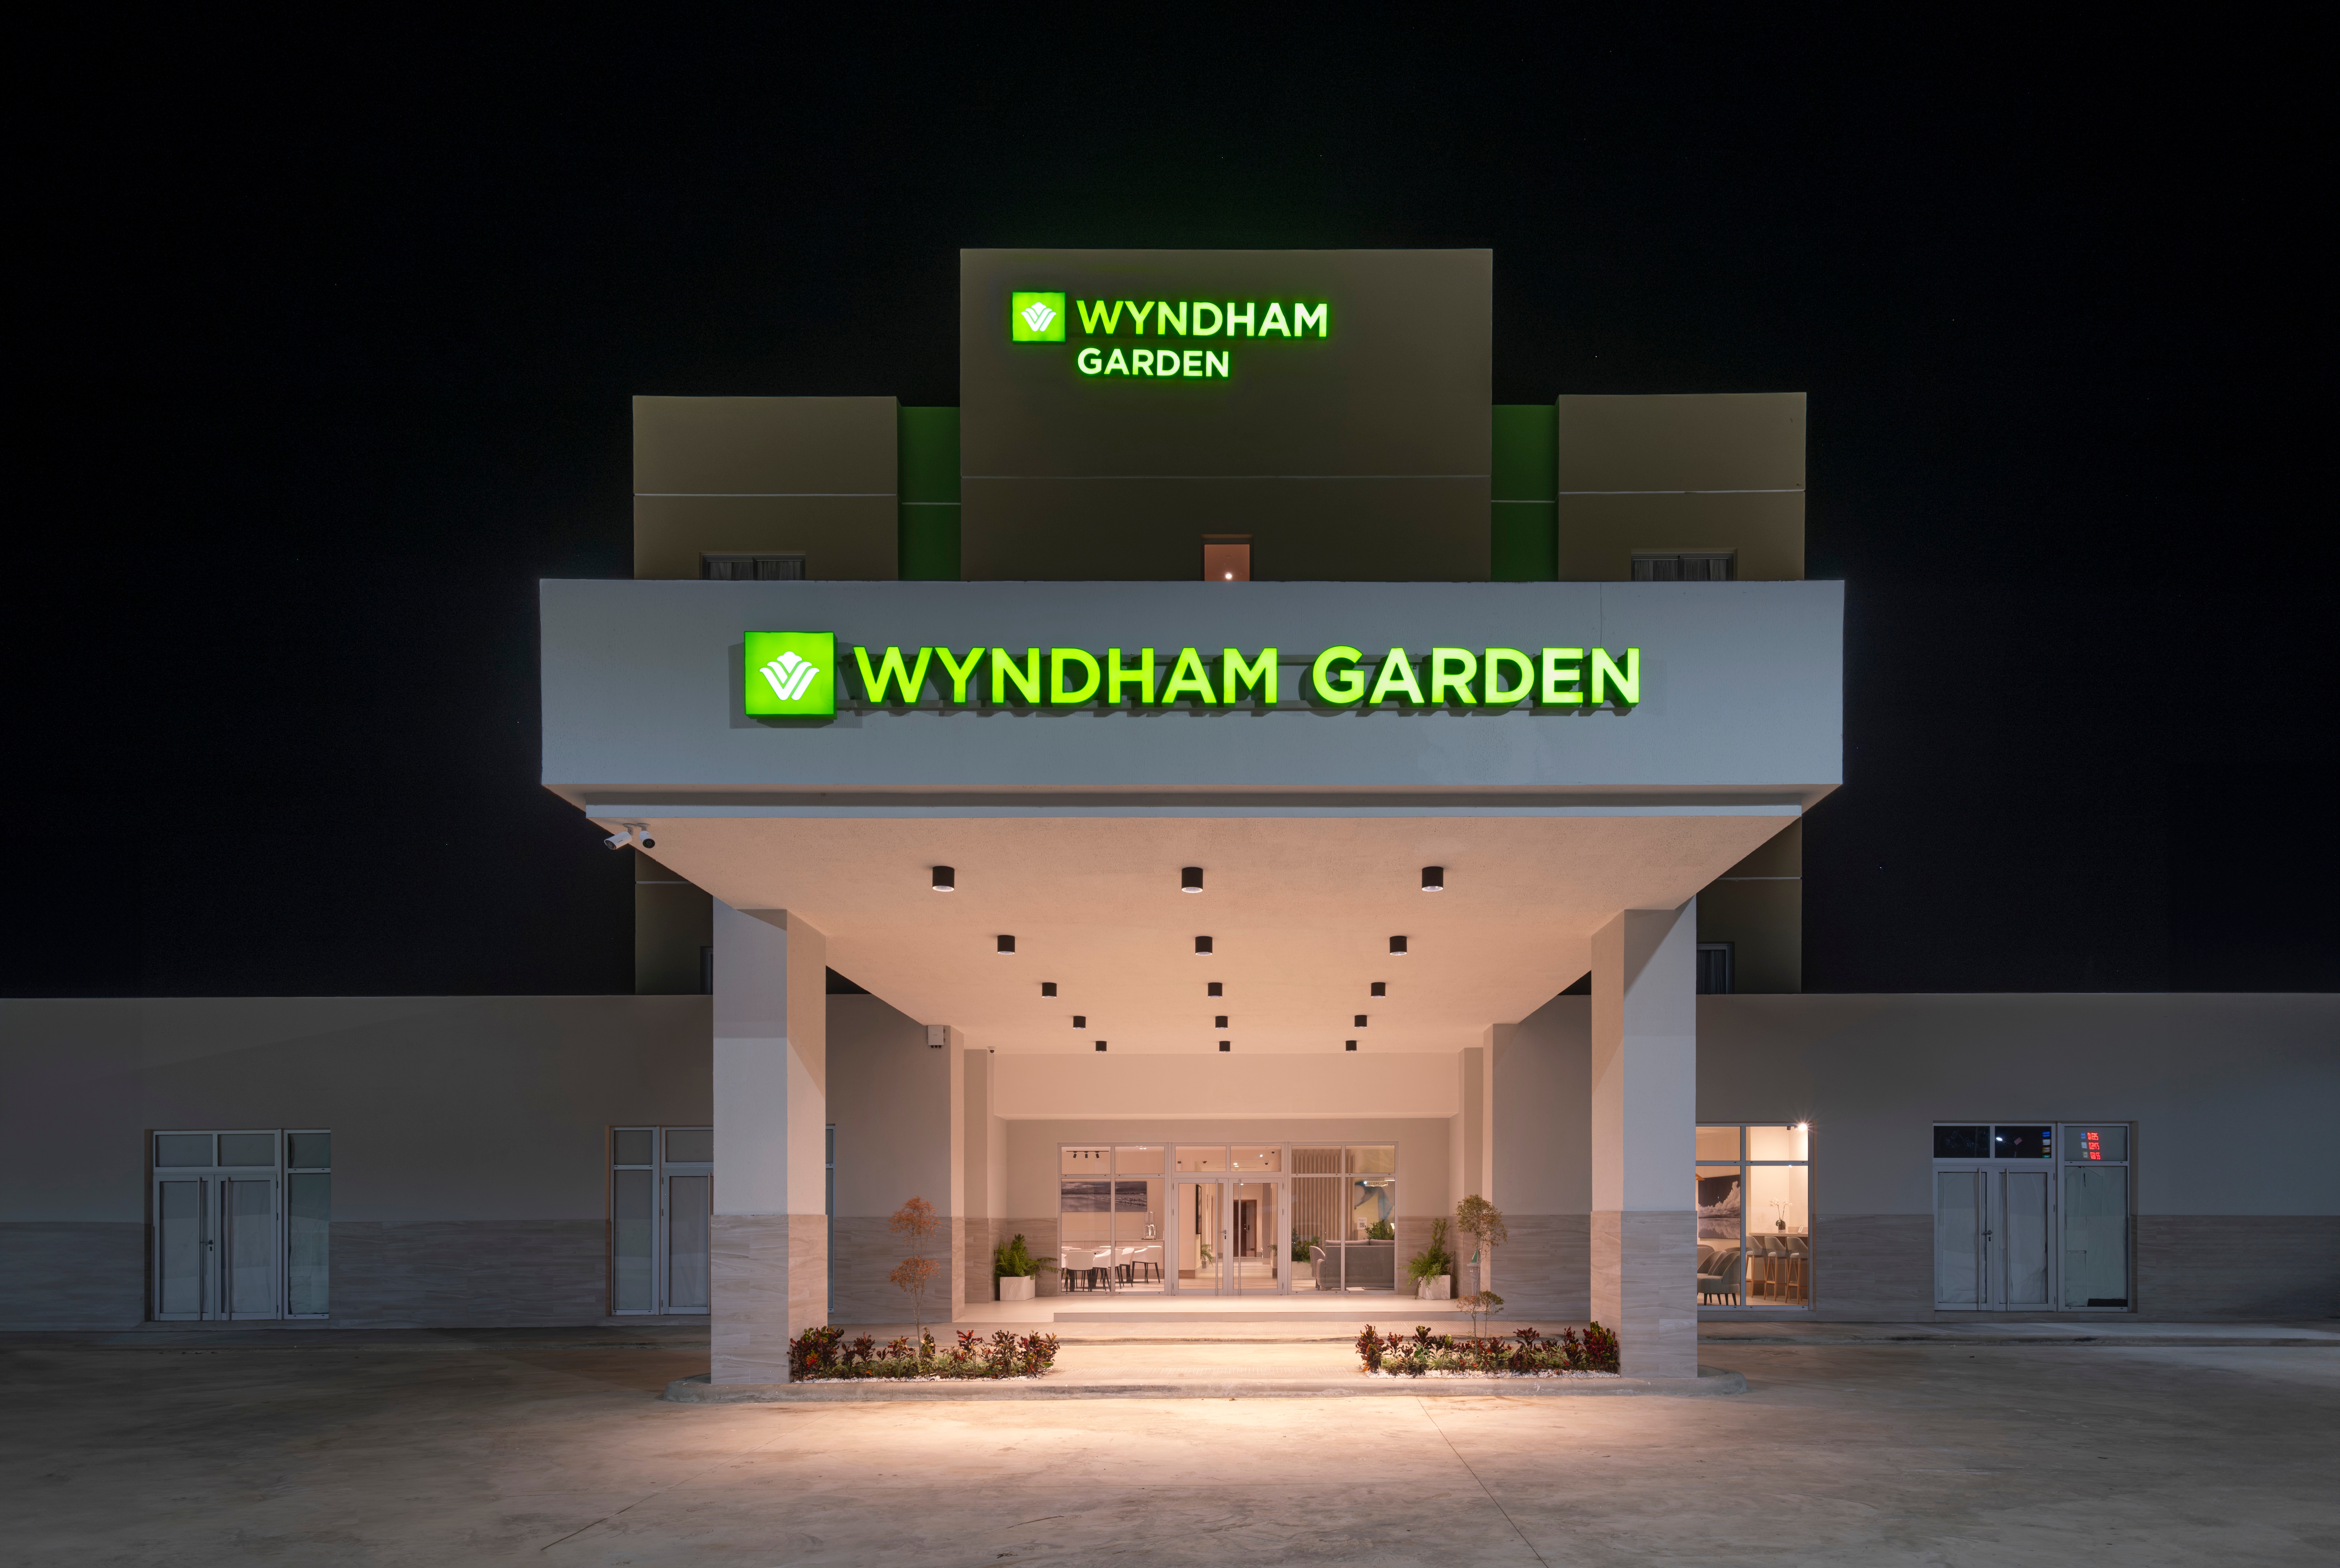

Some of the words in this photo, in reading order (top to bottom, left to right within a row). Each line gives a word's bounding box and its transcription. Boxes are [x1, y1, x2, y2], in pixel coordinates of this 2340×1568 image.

[1075, 299, 1328, 338] WYNDHAM
[1077, 347, 1230, 378] GARDEN
[852, 646, 1279, 705] WYNDHAM
[1311, 645, 1640, 706] GARDEN
